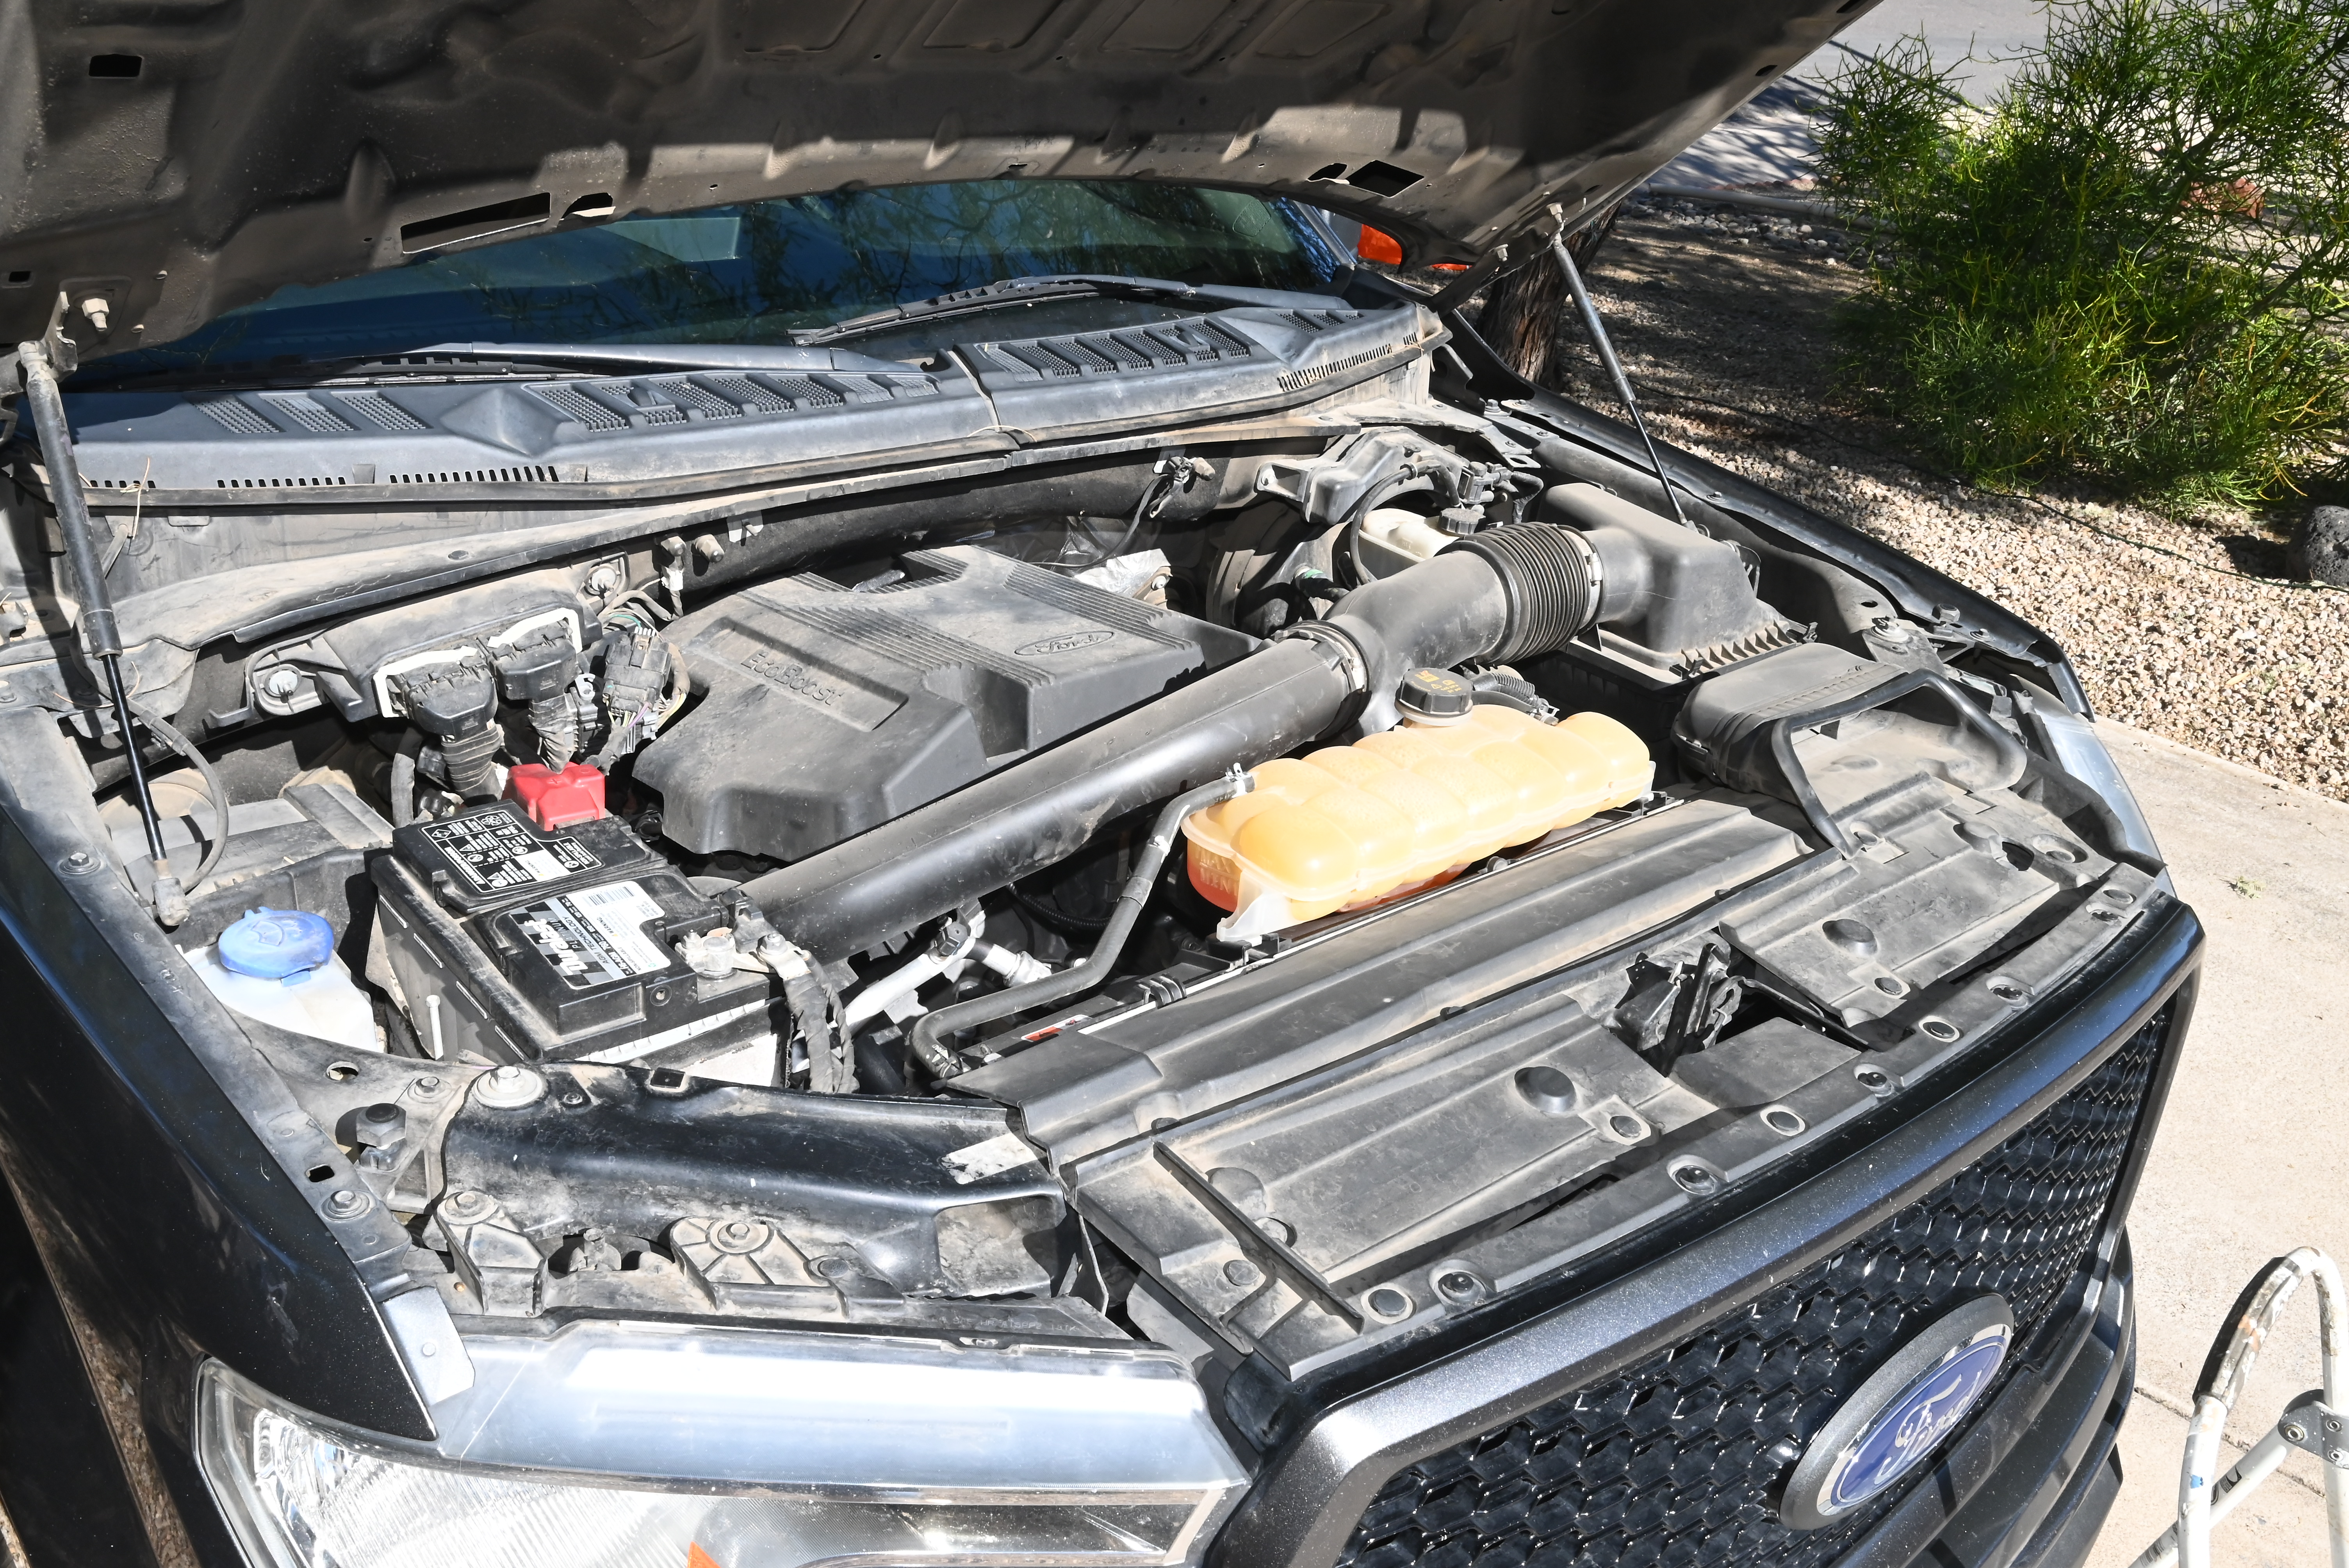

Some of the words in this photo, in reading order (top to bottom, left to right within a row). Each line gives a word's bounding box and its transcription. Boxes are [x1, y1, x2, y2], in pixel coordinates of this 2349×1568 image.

[1035, 634, 1100, 654] Ford
[741, 649, 845, 706] EcoBoost
[523, 918, 589, 975] Duralast
[547, 917, 581, 949] PLATINUM
[561, 917, 597, 950] TECHNOLOGY
[598, 940, 611, 950] 760
[593, 951, 610, 964] AGM
[932, 1044, 944, 1053] RAD
[1874, 1370, 1982, 1485] Ford
